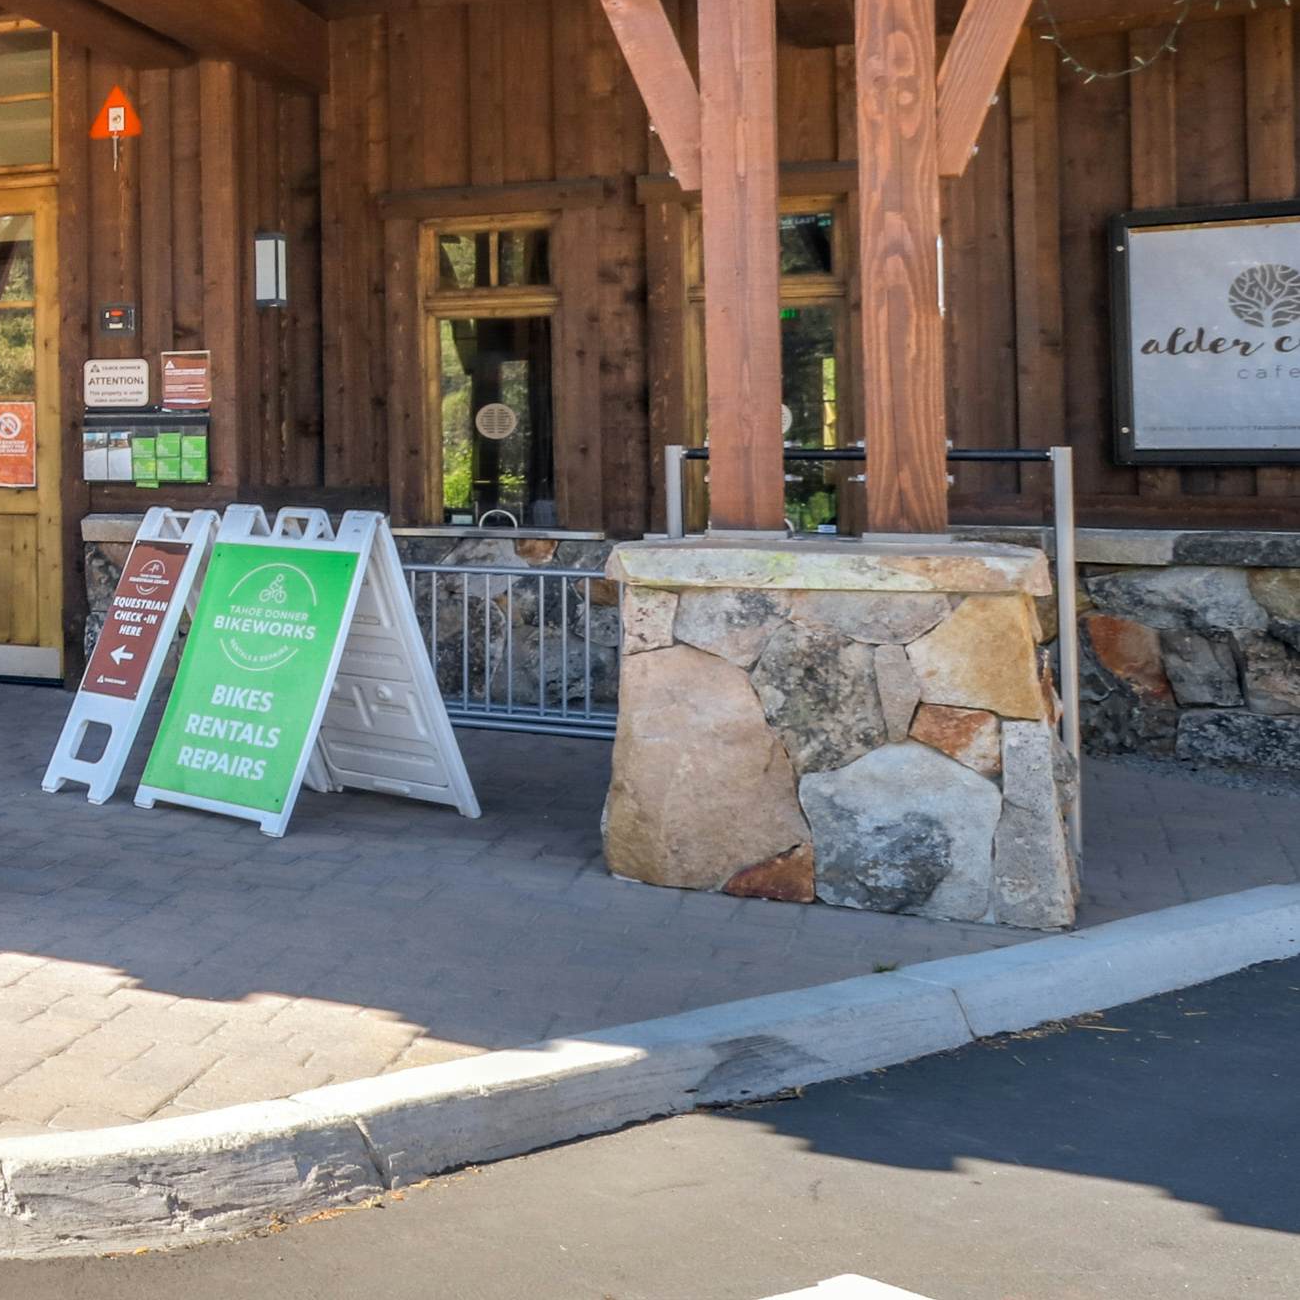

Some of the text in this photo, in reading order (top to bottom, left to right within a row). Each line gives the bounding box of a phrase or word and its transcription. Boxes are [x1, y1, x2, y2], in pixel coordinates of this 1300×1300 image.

[1140, 326, 1265, 357] alder
[88, 376, 145, 386] ATTENTION!
[113, 595, 169, 612] EQUESTRIAN
[230, 604, 309, 621] TAHOE DONNER
[119, 624, 143, 637] HERE
[213, 615, 317, 641] BIKEWORKS
[211, 684, 275, 713] BIKES
[184, 713, 282, 749] RENTALS
[176, 745, 268, 781] REPAIRS
